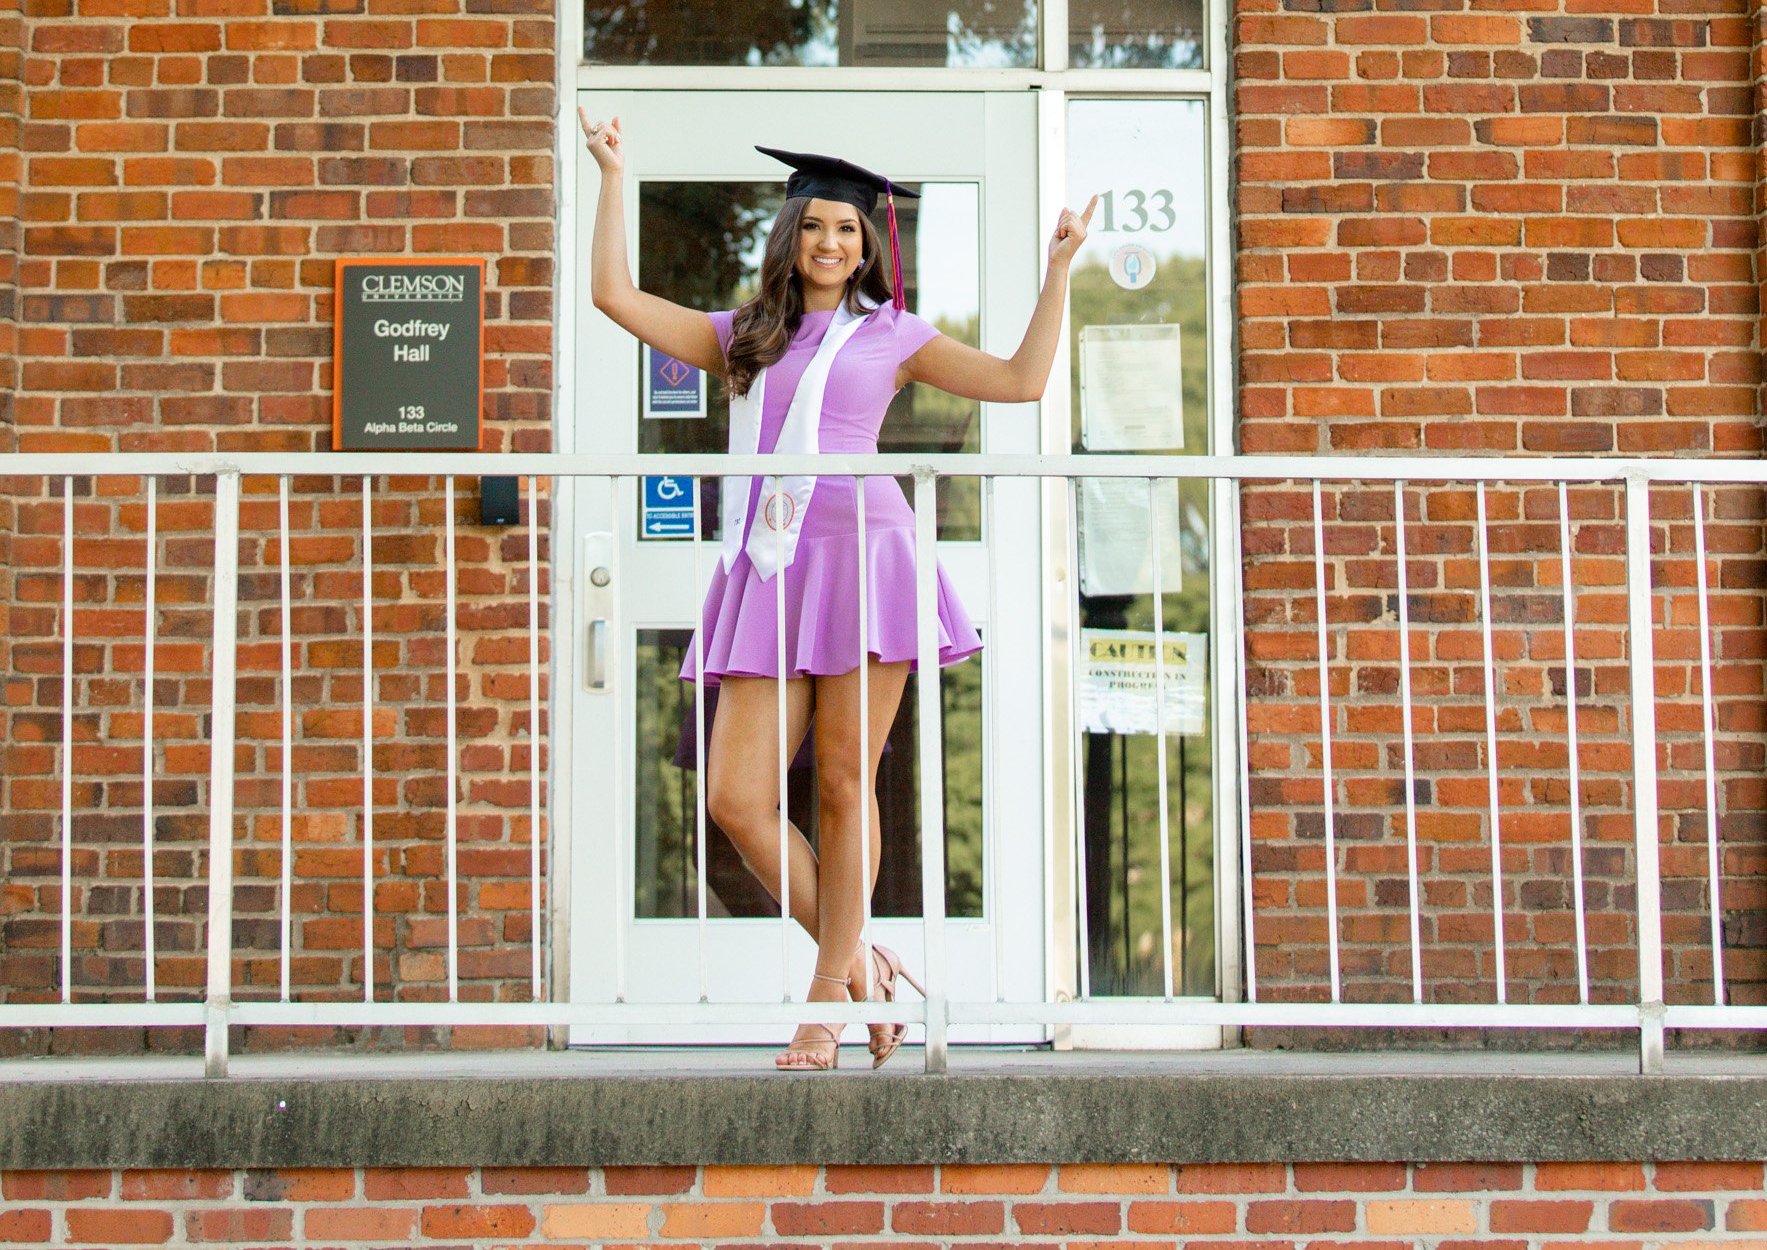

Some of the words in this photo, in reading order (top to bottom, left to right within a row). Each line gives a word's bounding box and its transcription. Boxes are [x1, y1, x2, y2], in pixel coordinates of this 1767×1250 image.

[1098, 189, 1176, 232] 133
[362, 275, 464, 292] CLEMSON
[374, 319, 450, 340] Godfrey
[393, 344, 430, 362] Hall
[398, 406, 425, 419] 133
[363, 422, 396, 435] Alpha
[398, 422, 424, 433] Beta
[426, 422, 458, 433] Circle
[1089, 642, 1187, 661] CAUTIN
[1088, 670, 1171, 680] CONSTRUCTIN
[1175, 672, 1187, 681] IN
[1109, 681, 1167, 691] PROGRE
